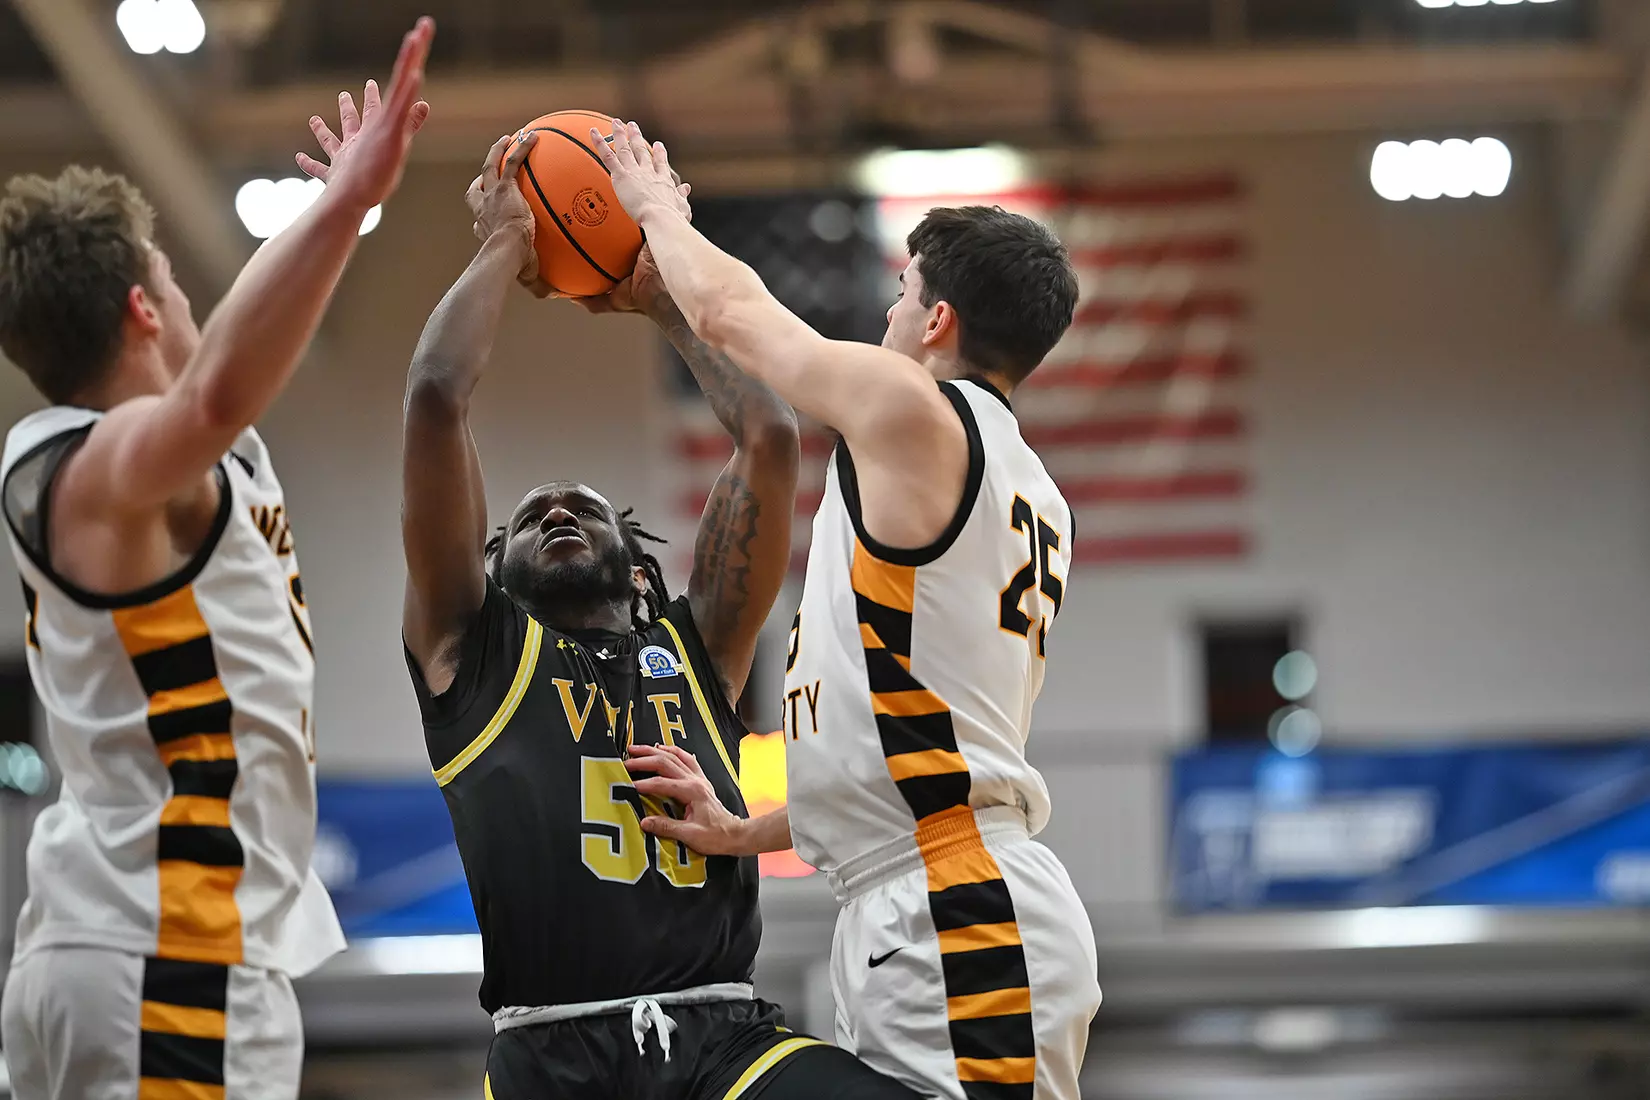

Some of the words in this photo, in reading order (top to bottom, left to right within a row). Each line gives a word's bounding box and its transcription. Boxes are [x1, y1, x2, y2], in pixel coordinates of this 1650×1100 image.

[998, 491, 1063, 660] 25
[649, 656, 668, 670] 50
[782, 679, 821, 744] TY
